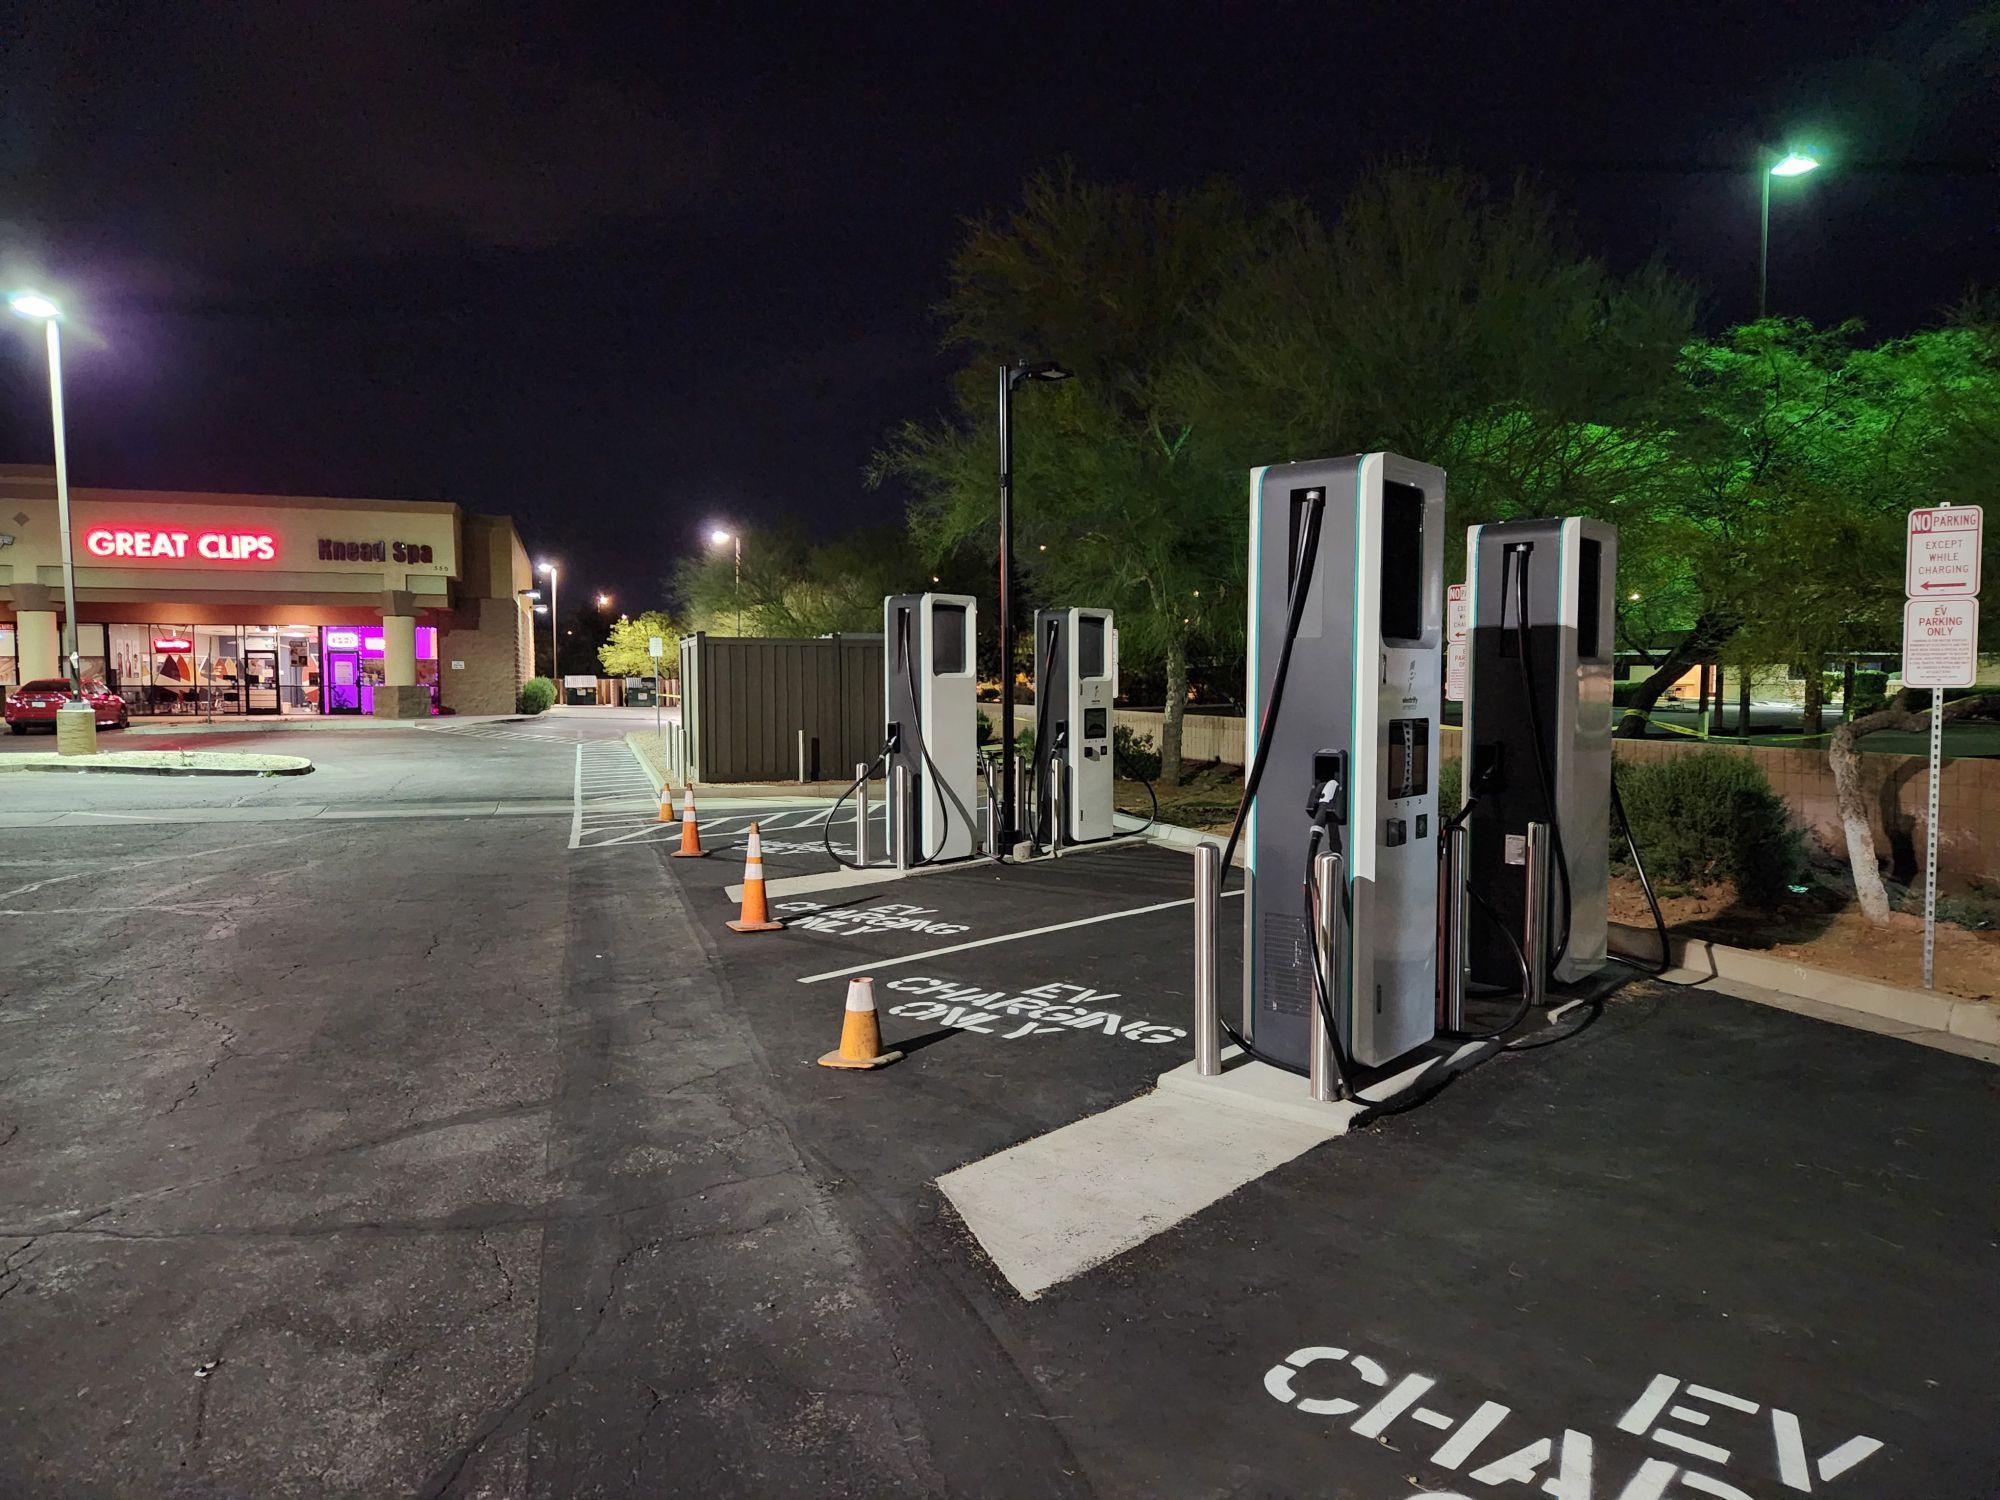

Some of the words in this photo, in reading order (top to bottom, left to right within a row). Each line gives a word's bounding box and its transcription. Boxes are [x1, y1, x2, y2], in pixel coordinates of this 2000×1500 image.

[1912, 513, 1931, 531] NO
[1933, 514, 1976, 527] PARKING
[87, 531, 189, 558] GREAT
[198, 534, 275, 560] CLIPS
[318, 539, 385, 562] Knead
[392, 541, 433, 565] Spa
[1925, 540, 1963, 550] EXCEPT
[1929, 553, 1958, 561] WHILE
[1918, 565, 1969, 575] CHARGING
[1934, 607, 1947, 616] EV
[1919, 617, 1963, 626] PARKING
[1927, 627, 1954, 636] ONLY
[772, 916, 888, 936] NLY
[1020, 982, 1121, 1003] EV
[887, 977, 1187, 1043] CHARGING
[888, 1001, 1066, 1039] ONLY
[1616, 1373, 1884, 1493] EV
